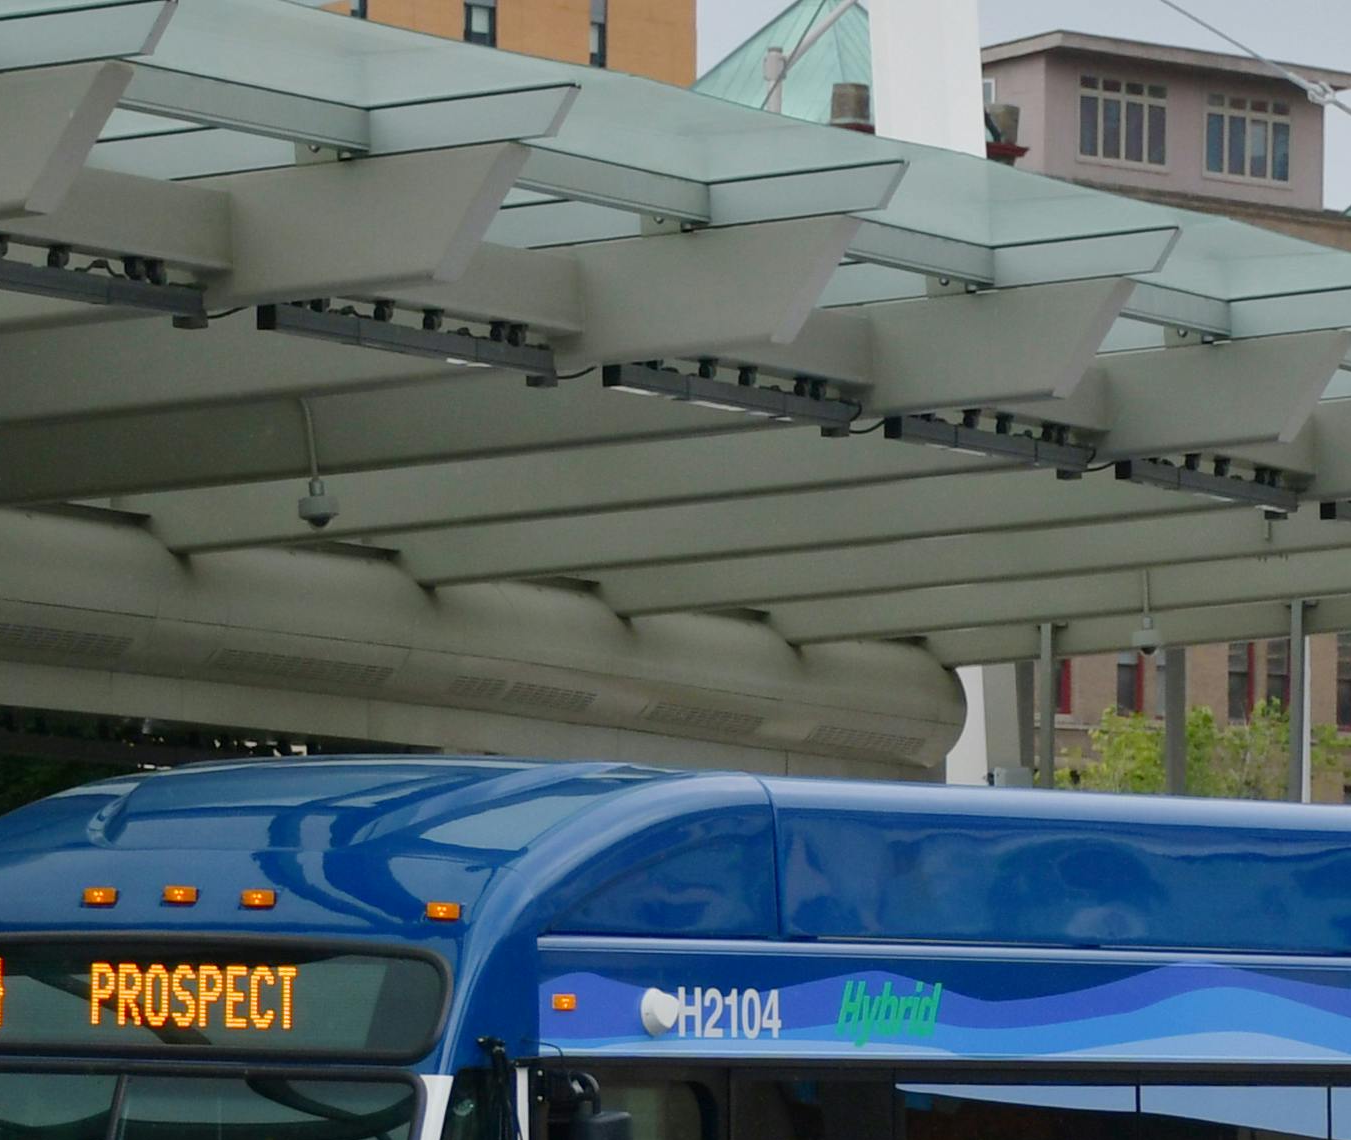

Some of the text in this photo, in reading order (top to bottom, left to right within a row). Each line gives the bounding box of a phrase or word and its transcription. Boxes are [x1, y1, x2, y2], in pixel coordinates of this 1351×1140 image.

[91, 962, 297, 1029] PROSPECT
[677, 985, 782, 1039] H2104
[835, 980, 943, 1047] Hybrid
